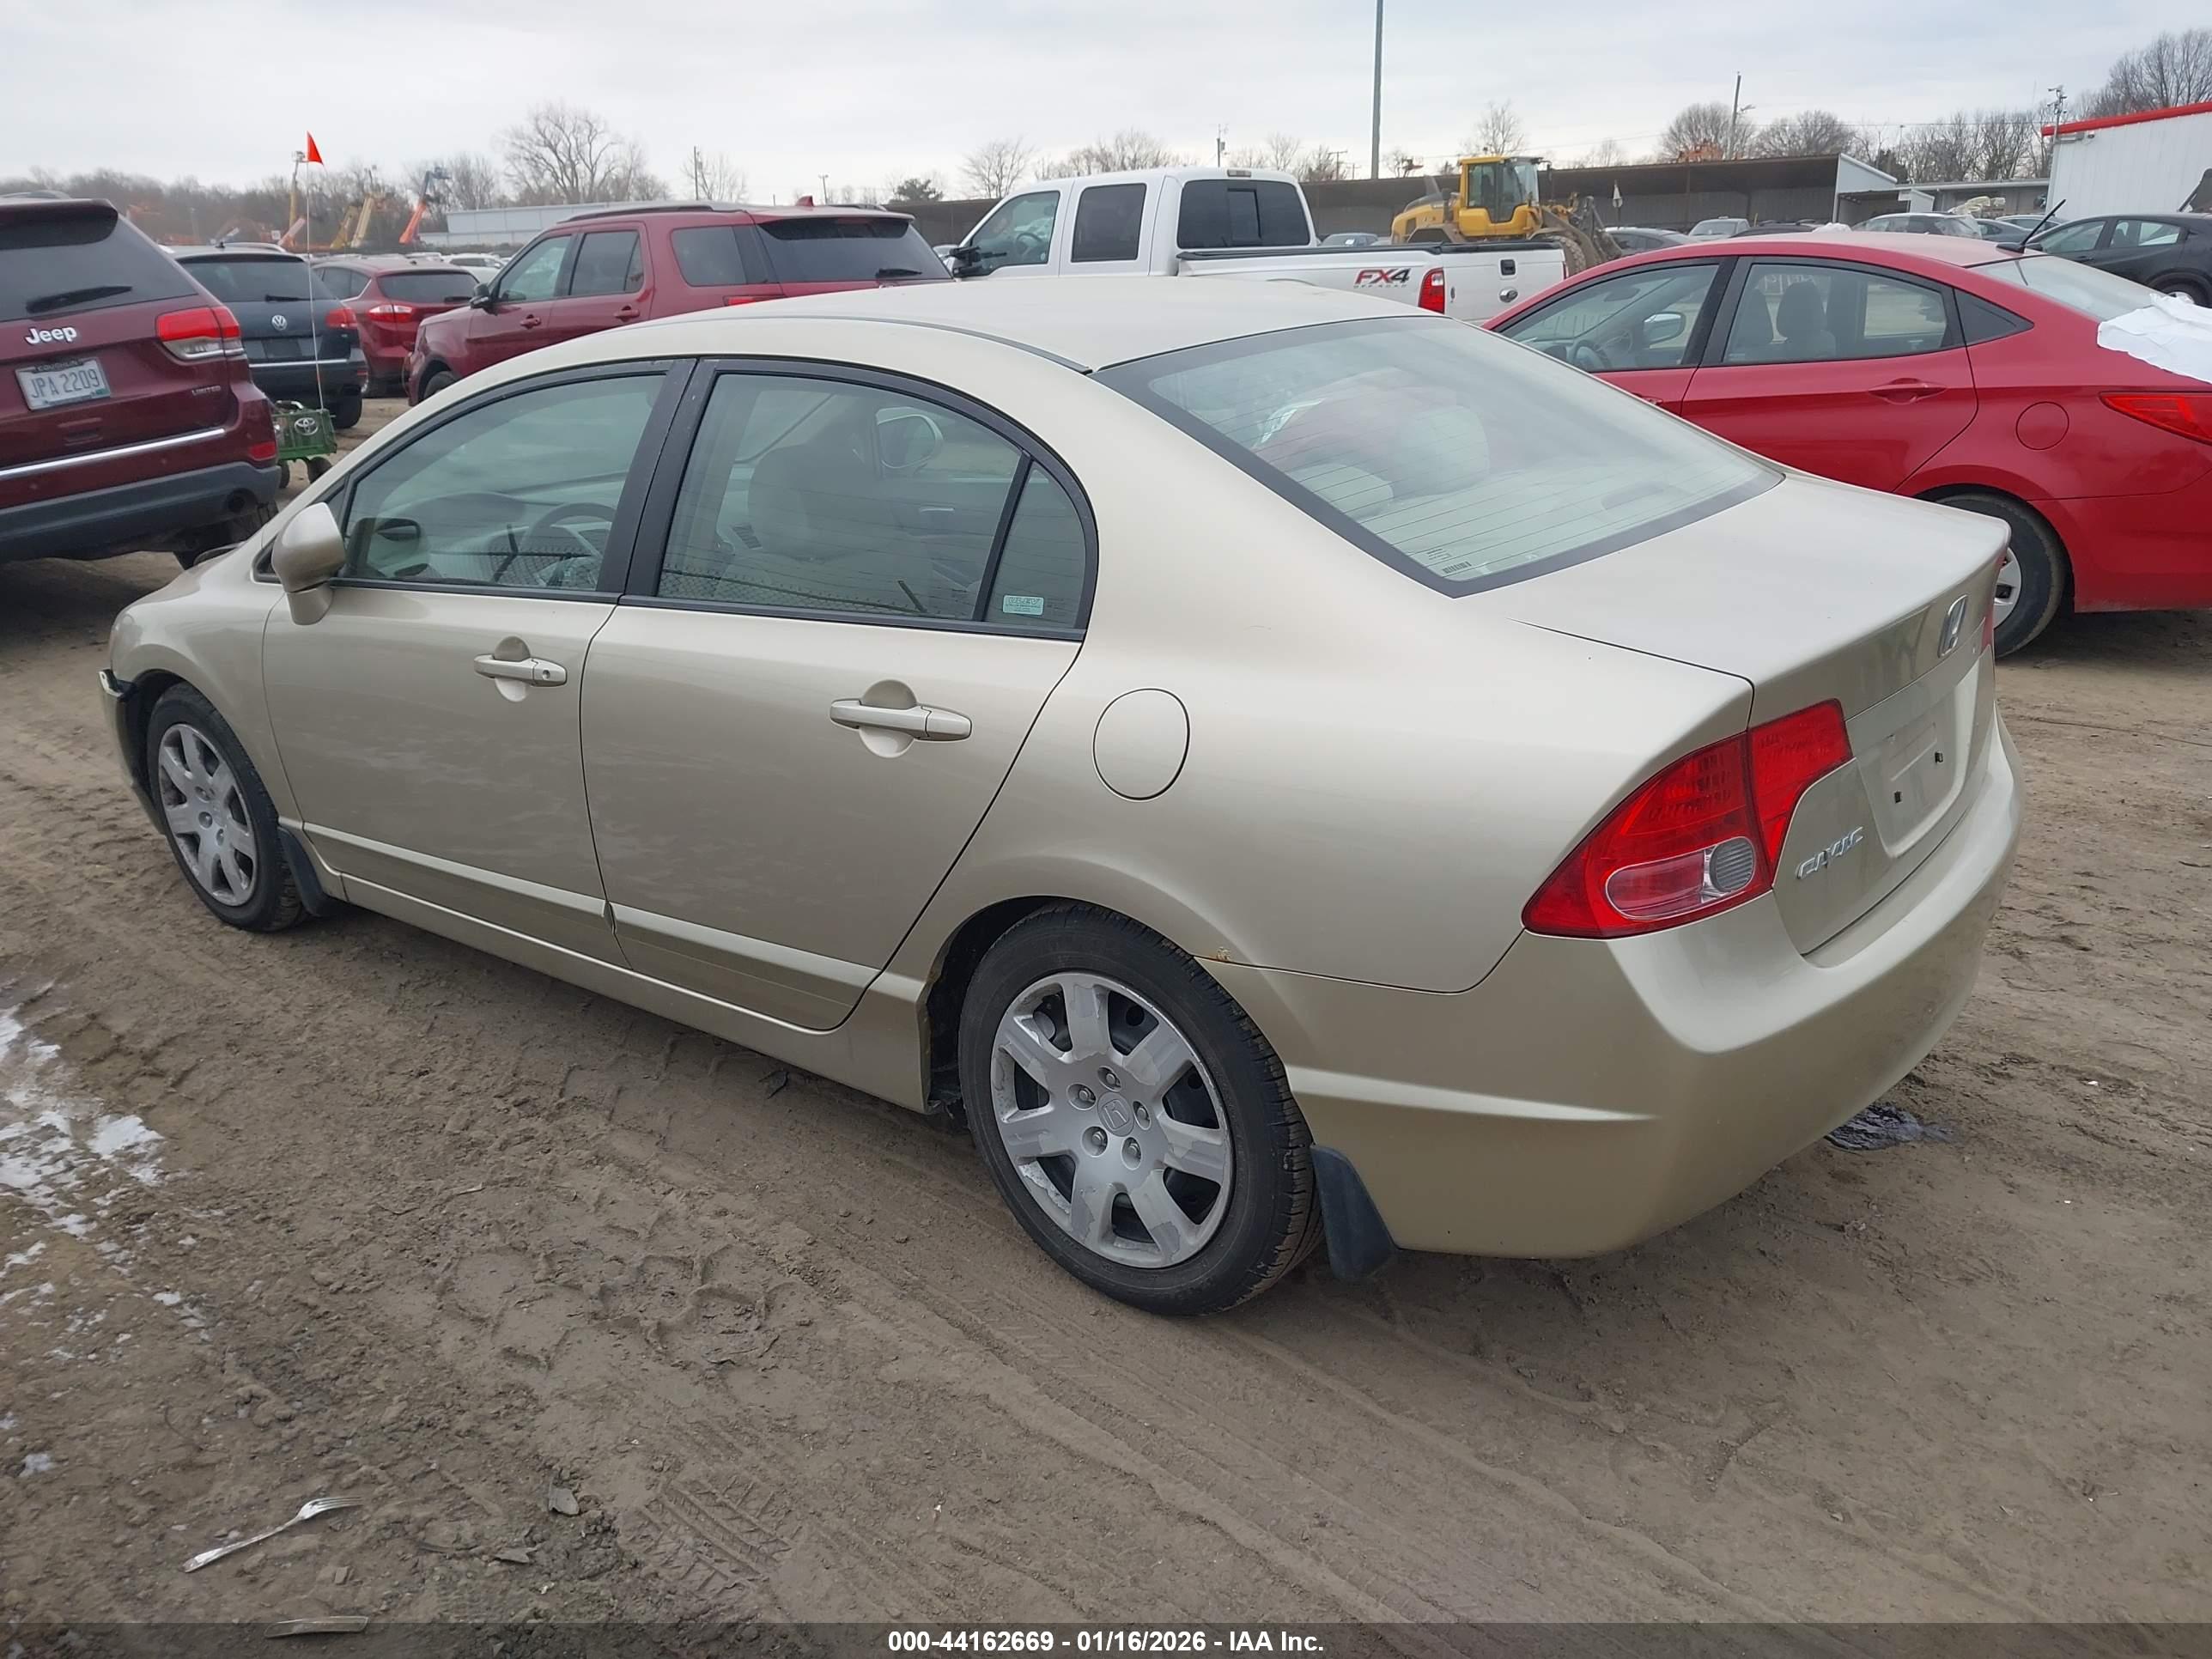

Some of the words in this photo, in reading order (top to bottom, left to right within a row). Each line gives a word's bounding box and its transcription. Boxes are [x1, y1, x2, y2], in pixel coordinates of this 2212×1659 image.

[1354, 268, 1411, 284] FX4
[25, 327, 77, 344] Jeep
[31, 377, 59, 398] JPA
[60, 368, 100, 393] 2209
[1795, 826, 1864, 879] CIVIC
